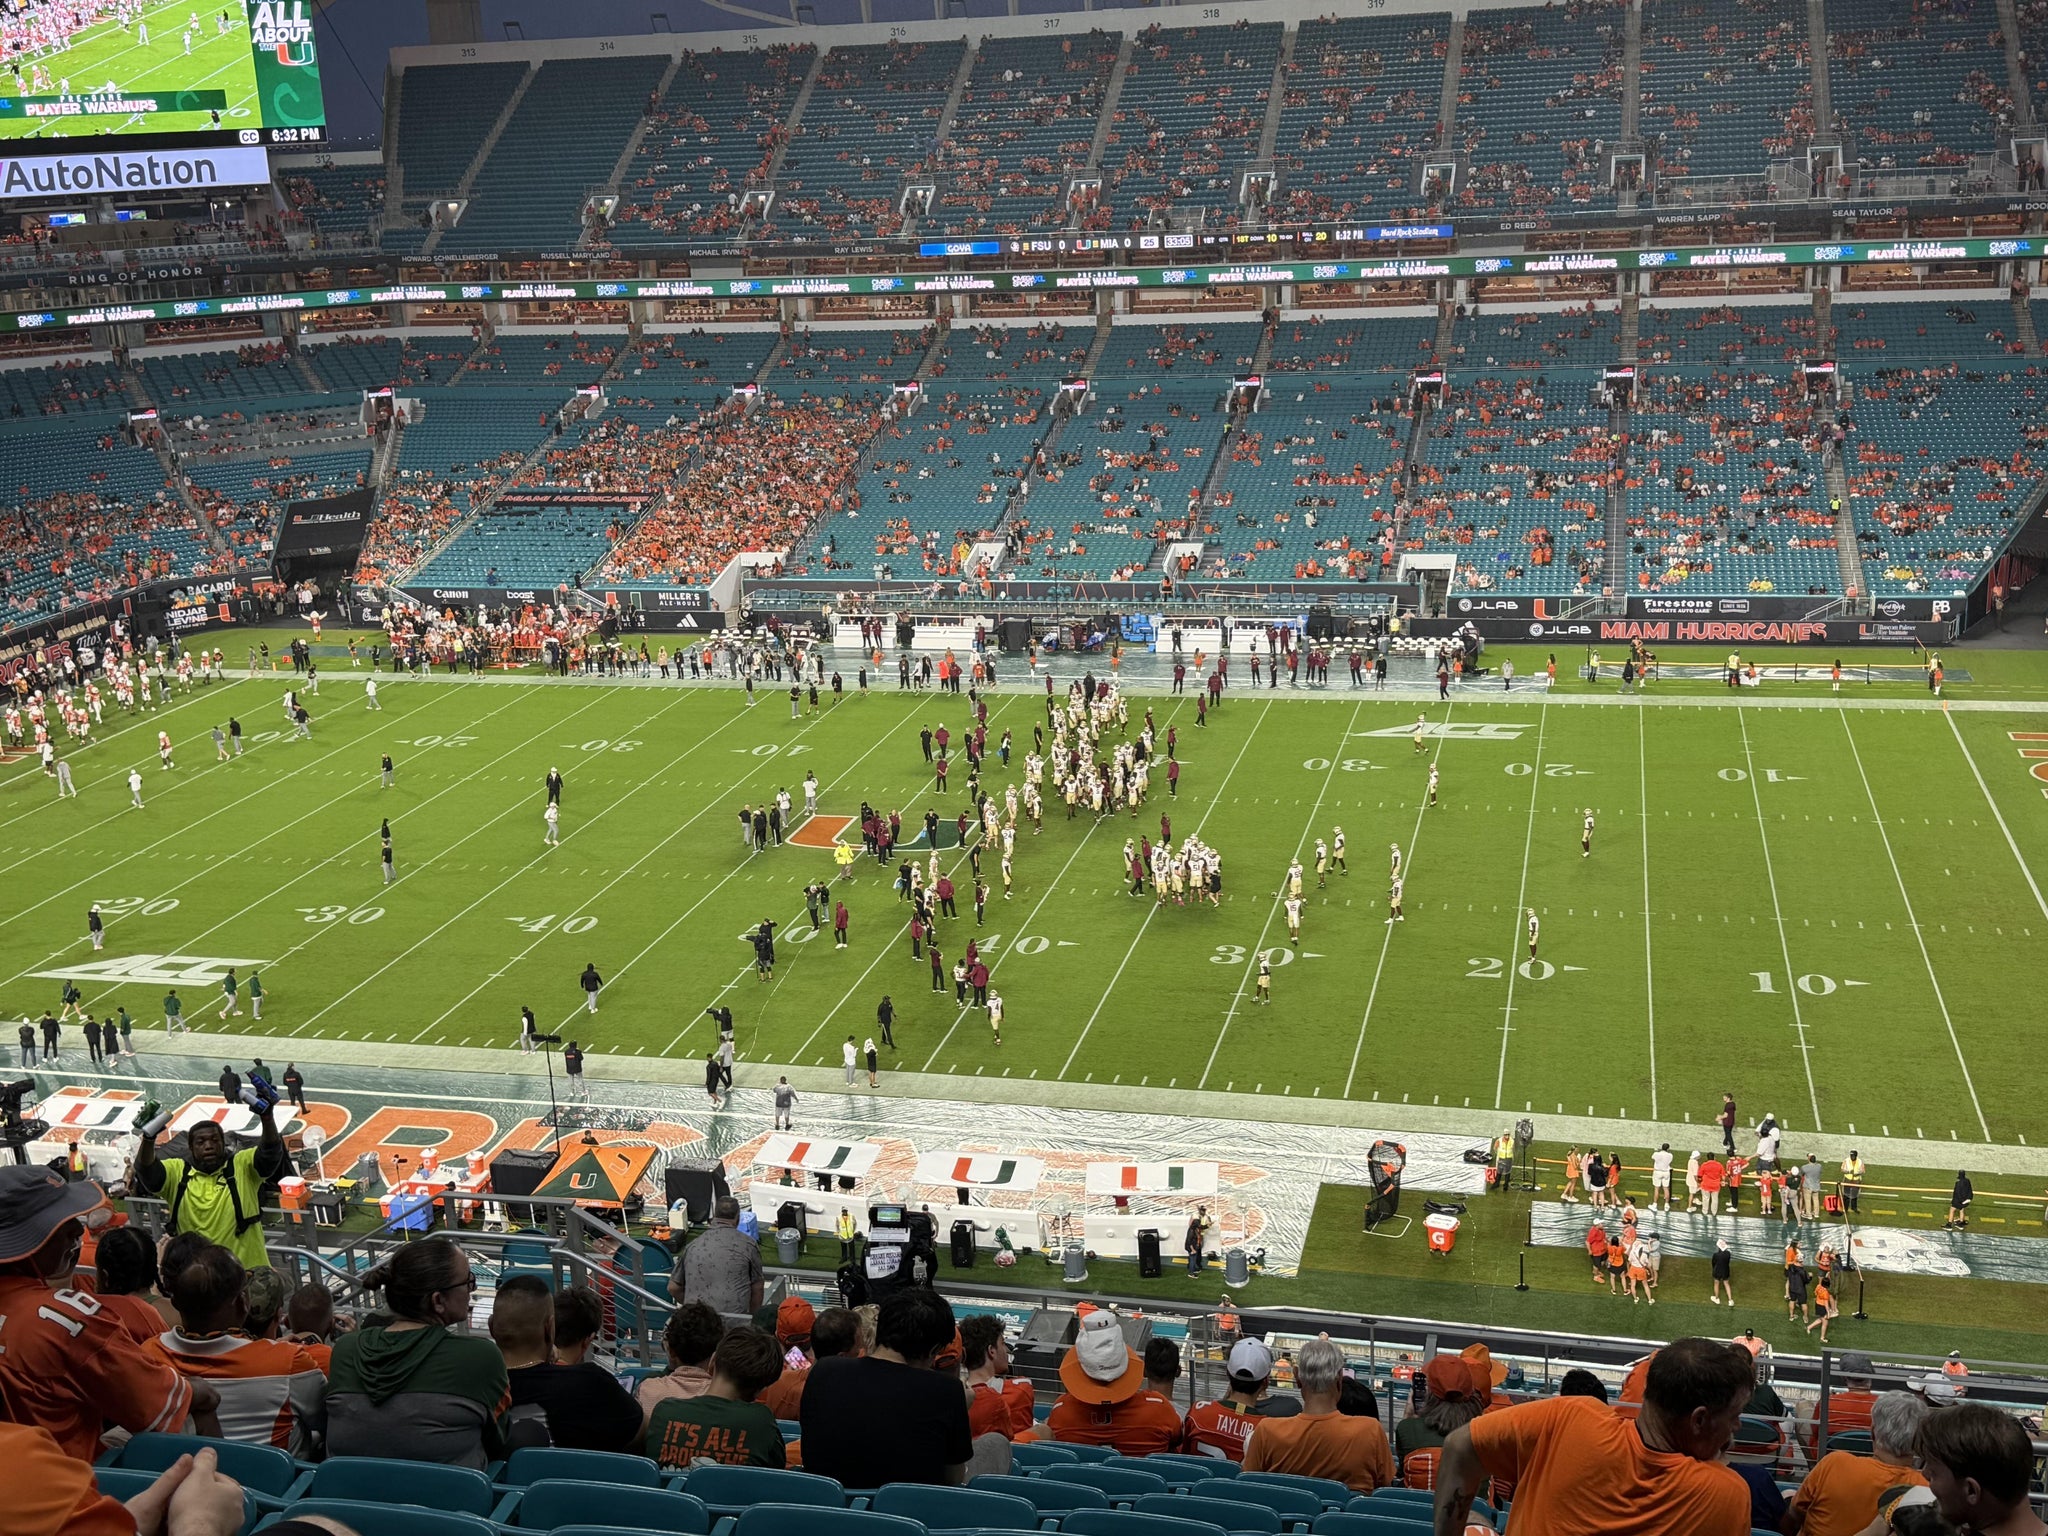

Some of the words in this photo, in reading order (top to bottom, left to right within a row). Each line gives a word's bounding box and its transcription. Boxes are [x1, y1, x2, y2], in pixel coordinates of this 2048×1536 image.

[1367, 0, 1385, 9] 319
[252, 1, 310, 28] ALL
[1203, 9, 1220, 19] 318
[1043, 19, 1060, 29] 317
[251, 27, 312, 43] ABOUT
[890, 27, 906, 37] 316
[742, 35, 758, 44] 315
[600, 41, 615, 50] 314
[461, 48, 476, 57] 313
[60, 93, 123, 103] PRE-GAME
[25, 102, 82, 116] PLAYER
[84, 99, 158, 113] WARMUPS
[272, 129, 298, 142] 6:32
[300, 127, 321, 140] PM
[315, 155, 331, 164] 312
[4, 155, 217, 193] AutoNation
[2007, 203, 2023, 211] JIM
[1832, 209, 1856, 217] SEAN
[1859, 208, 1893, 217] TAYLOR
[1657, 215, 1694, 223] WARREN
[1697, 214, 1720, 222] SAPP
[1514, 222, 1537, 230] REED
[1166, 236, 1191, 246] 33:05
[1203, 236, 1215, 244] 1ST
[1236, 235, 1249, 243] 1ST
[1267, 233, 1278, 243] 10
[1315, 232, 1327, 241] 20
[1031, 241, 1051, 251] FSU
[1059, 240, 1066, 249] 0
[1101, 239, 1119, 249] MIA
[1124, 238, 1132, 248] 0
[1143, 238, 1156, 247] 25
[690, 249, 720, 257] MICHAEL
[722, 248, 740, 256] IRVIN
[851, 246, 873, 254] LEWIS
[401, 255, 432, 263] HOWARD
[541, 252, 570, 260] RUSSELL
[572, 251, 610, 259] MARYLAND
[68, 273, 108, 285] RING
[118, 272, 137, 281] OF
[148, 267, 203, 279] HONOR
[318, 511, 361, 521] Health
[187, 578, 236, 596] BACARDÍ
[433, 589, 469, 599] Canon
[506, 590, 535, 599] boost
[658, 592, 700, 601] MILLER'S
[1472, 601, 1519, 610] JLAB
[1643, 599, 1713, 609] Firestone
[164, 606, 207, 619] NIDJAR
[1544, 625, 1592, 635] JLAB
[1601, 622, 1669, 639] MIAMI
[1676, 621, 1827, 641] HURRICANES
[76, 630, 102, 649] Tito's
[303, 904, 387, 925] 30
[513, 915, 599, 935] 40
[975, 934, 1050, 955] 40
[1209, 945, 1295, 968] 30
[25, 954, 273, 987] ACC
[1465, 957, 1556, 981] 20
[1748, 971, 1839, 996] 10
[569, 1172, 598, 1190] U
[1431, 1231, 1445, 1245] G
[37, 1288, 102, 1338] 16
[663, 1420, 702, 1448] IT'S
[703, 1426, 750, 1453] ALL
